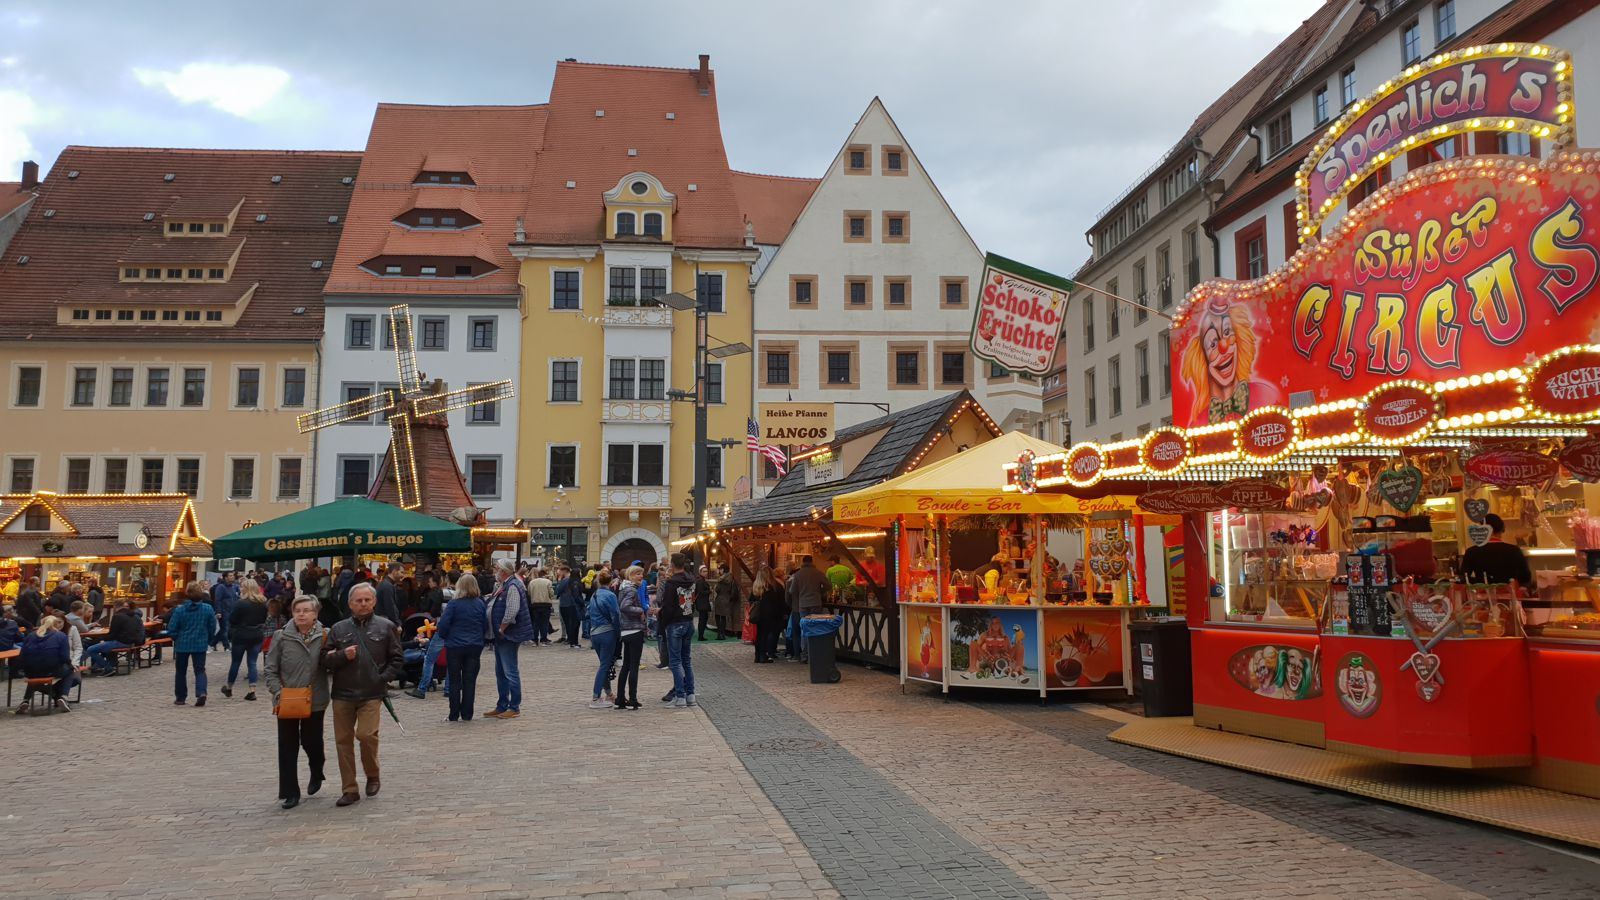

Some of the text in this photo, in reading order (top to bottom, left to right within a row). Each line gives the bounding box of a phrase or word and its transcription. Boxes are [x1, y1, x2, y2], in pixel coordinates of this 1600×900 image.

[1354, 197, 1498, 290] Süßer
[1292, 197, 1600, 380] CIRCUS
[982, 284, 1061, 326] Schoko-
[978, 308, 1056, 352] Früchte
[766, 409, 828, 418] Heiße Pfanne
[1374, 408, 1428, 427] MANDELN
[766, 427, 828, 439] LANGOS
[1251, 423, 1287, 438] LIEBES
[1073, 455, 1100, 474] POPCORN
[366, 532, 424, 547] Langos
